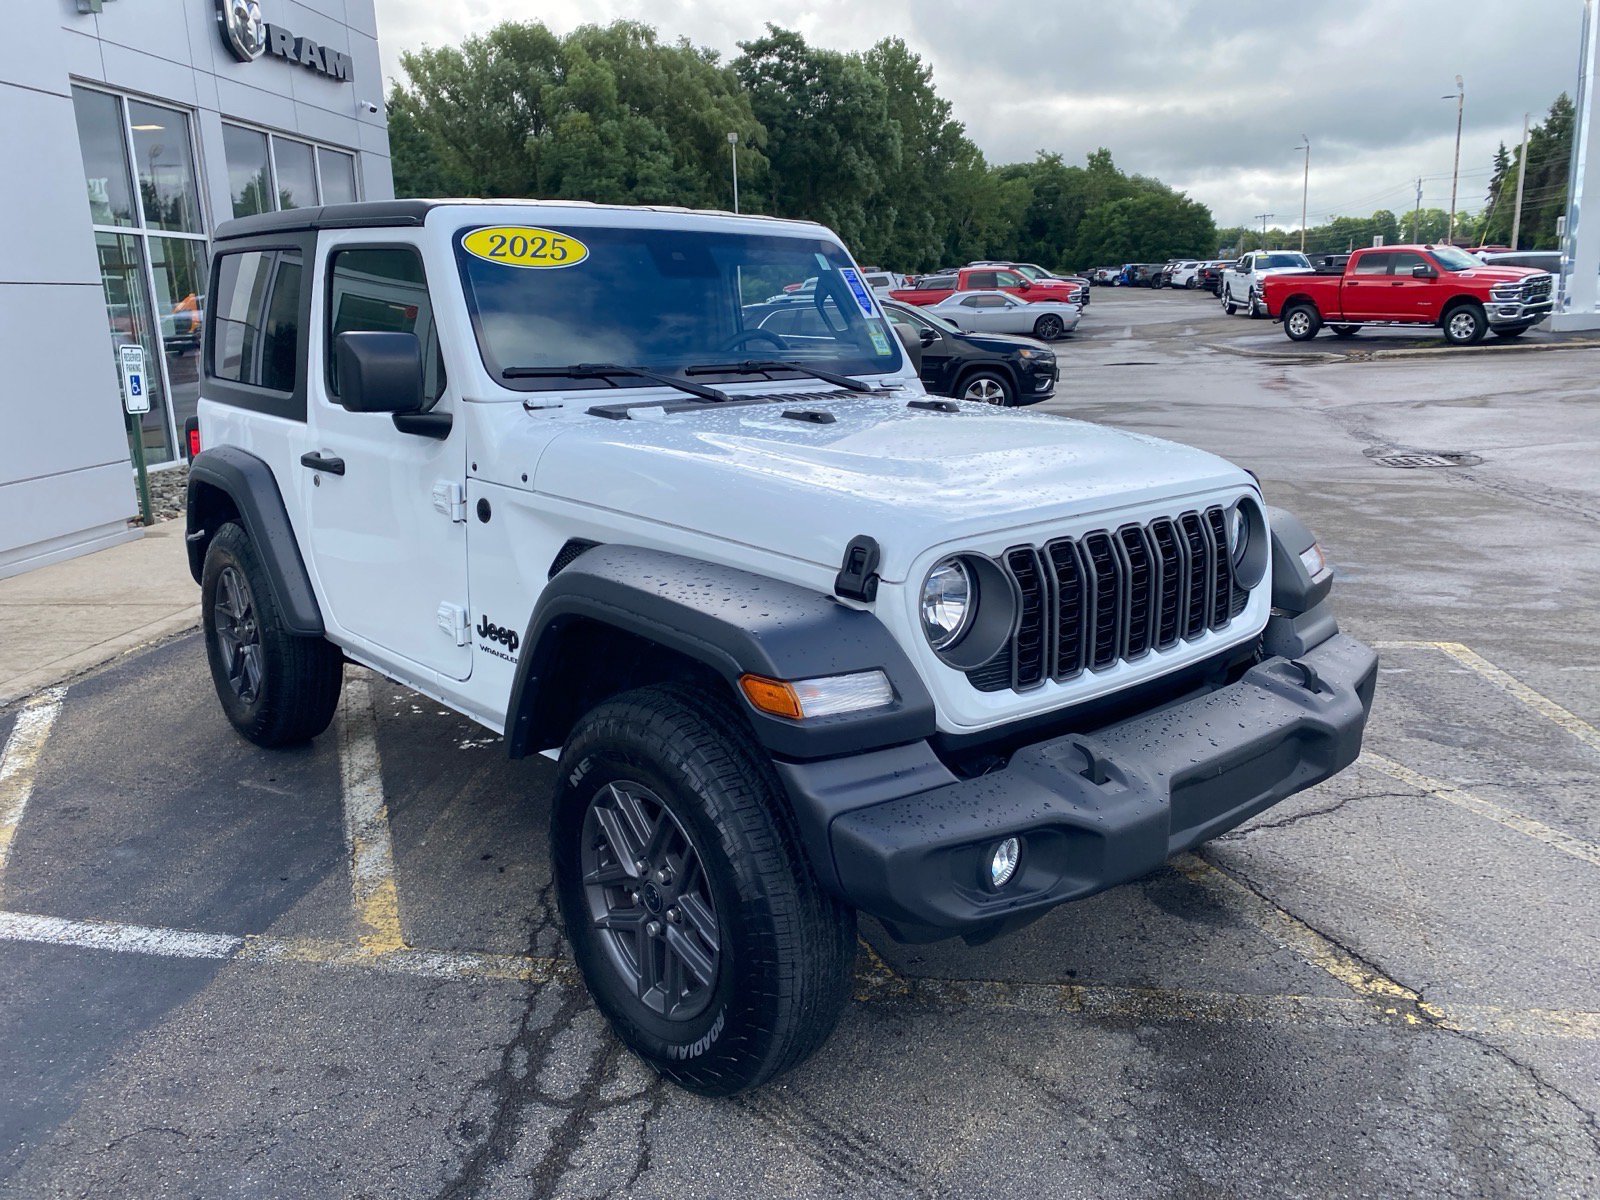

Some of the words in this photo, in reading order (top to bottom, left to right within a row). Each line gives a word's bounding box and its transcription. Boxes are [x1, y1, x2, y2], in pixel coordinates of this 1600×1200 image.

[265, 22, 354, 82] RAM
[489, 234, 568, 261] 2025
[477, 614, 519, 653] Jeep
